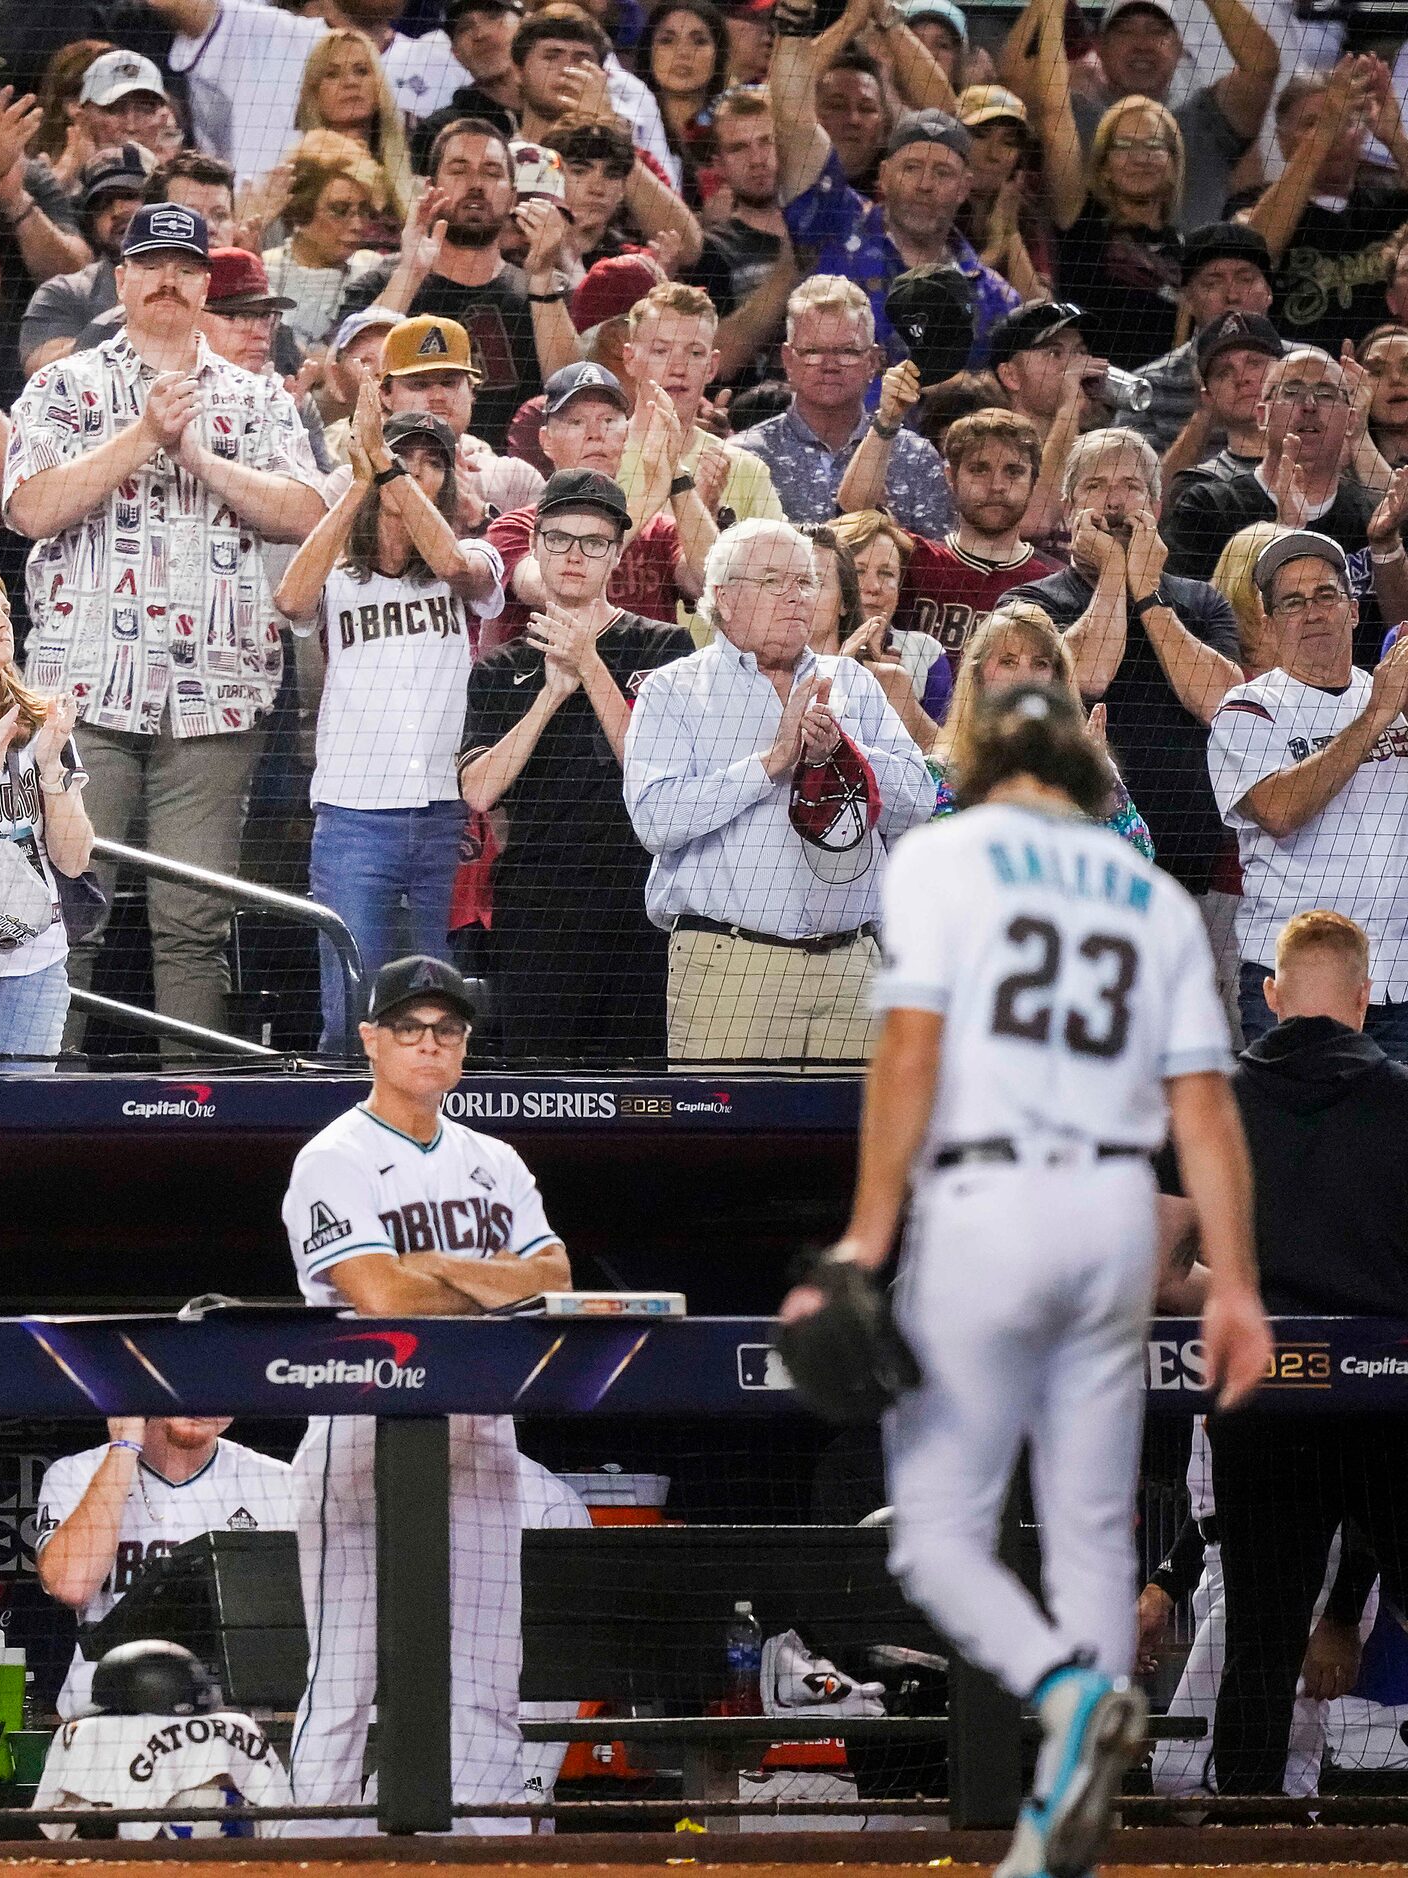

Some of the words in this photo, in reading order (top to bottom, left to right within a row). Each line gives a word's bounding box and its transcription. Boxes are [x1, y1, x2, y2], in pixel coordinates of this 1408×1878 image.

[990, 915, 1138, 1057] 23
[522, 1092, 617, 1119] SERIES
[620, 1099, 672, 1113] 2023
[305, 1221, 350, 1253] AVNET
